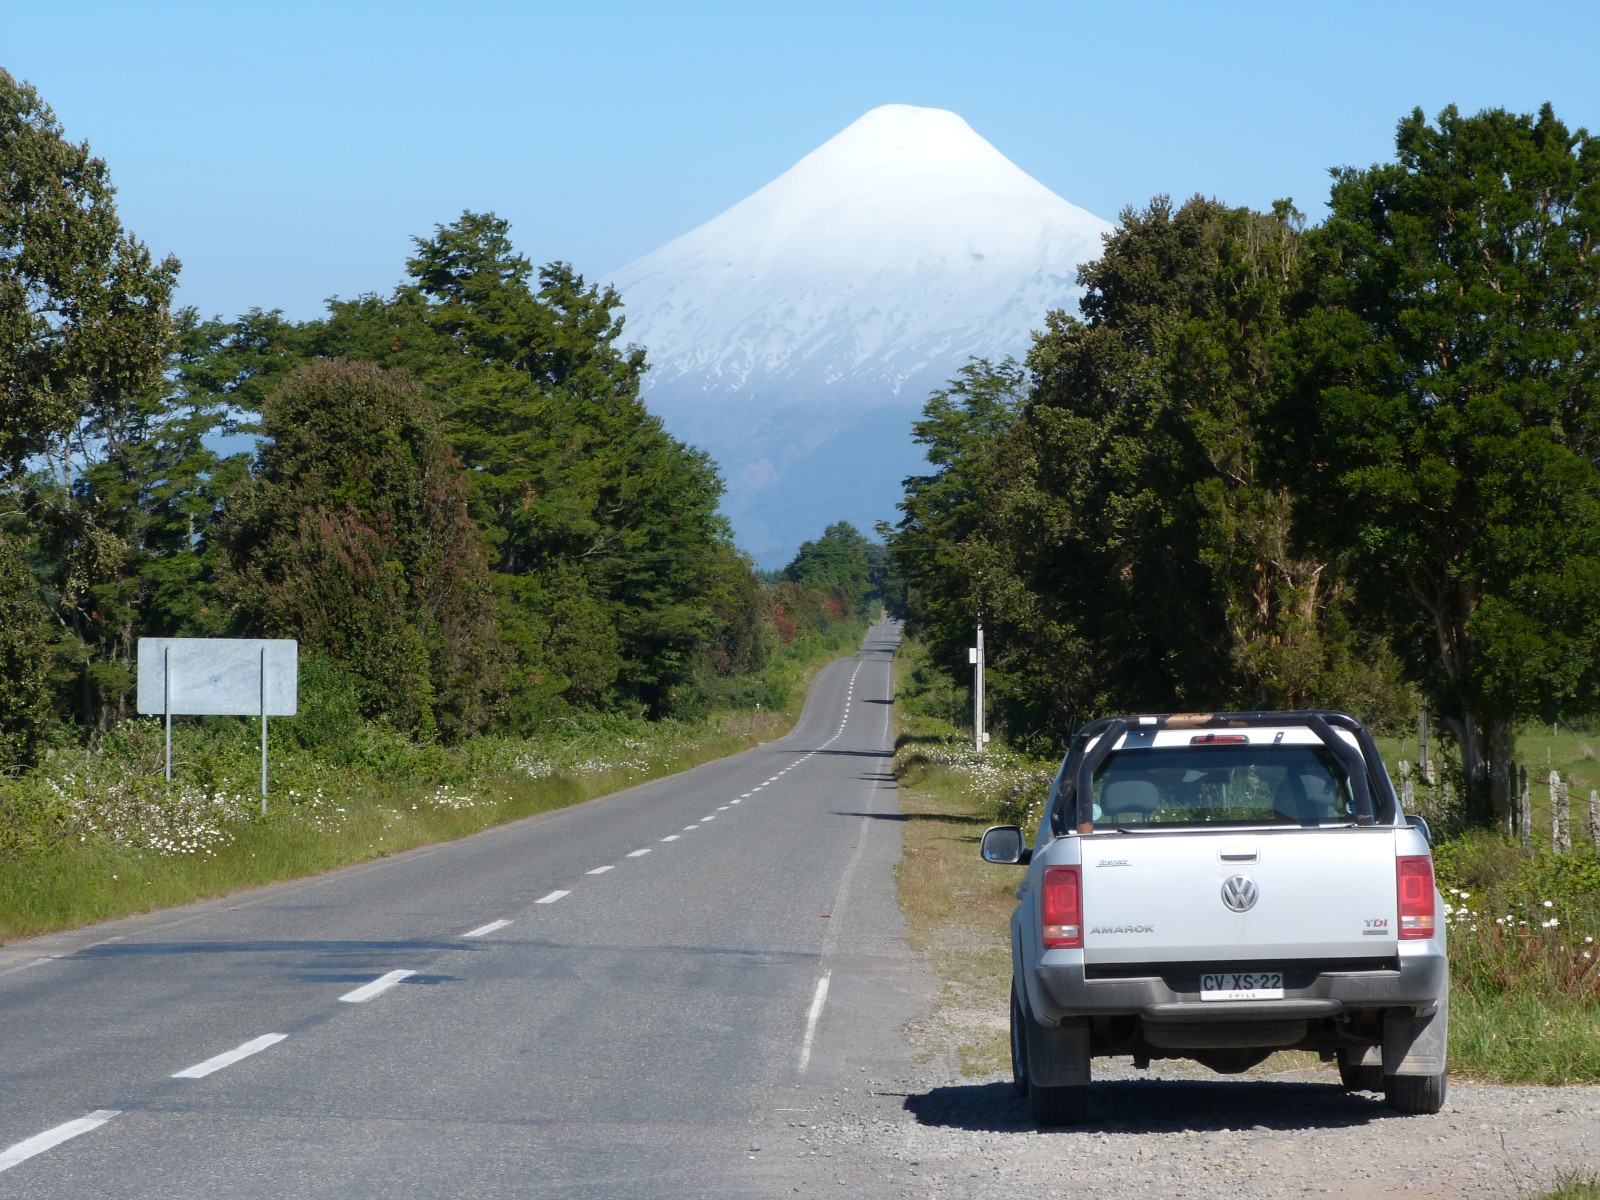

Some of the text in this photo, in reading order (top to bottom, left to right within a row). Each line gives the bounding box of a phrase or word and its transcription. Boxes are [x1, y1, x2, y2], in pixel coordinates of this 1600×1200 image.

[1222, 876, 1258, 912] VW
[1364, 919, 1388, 927] TDI
[1089, 925, 1155, 934] AMAROK
